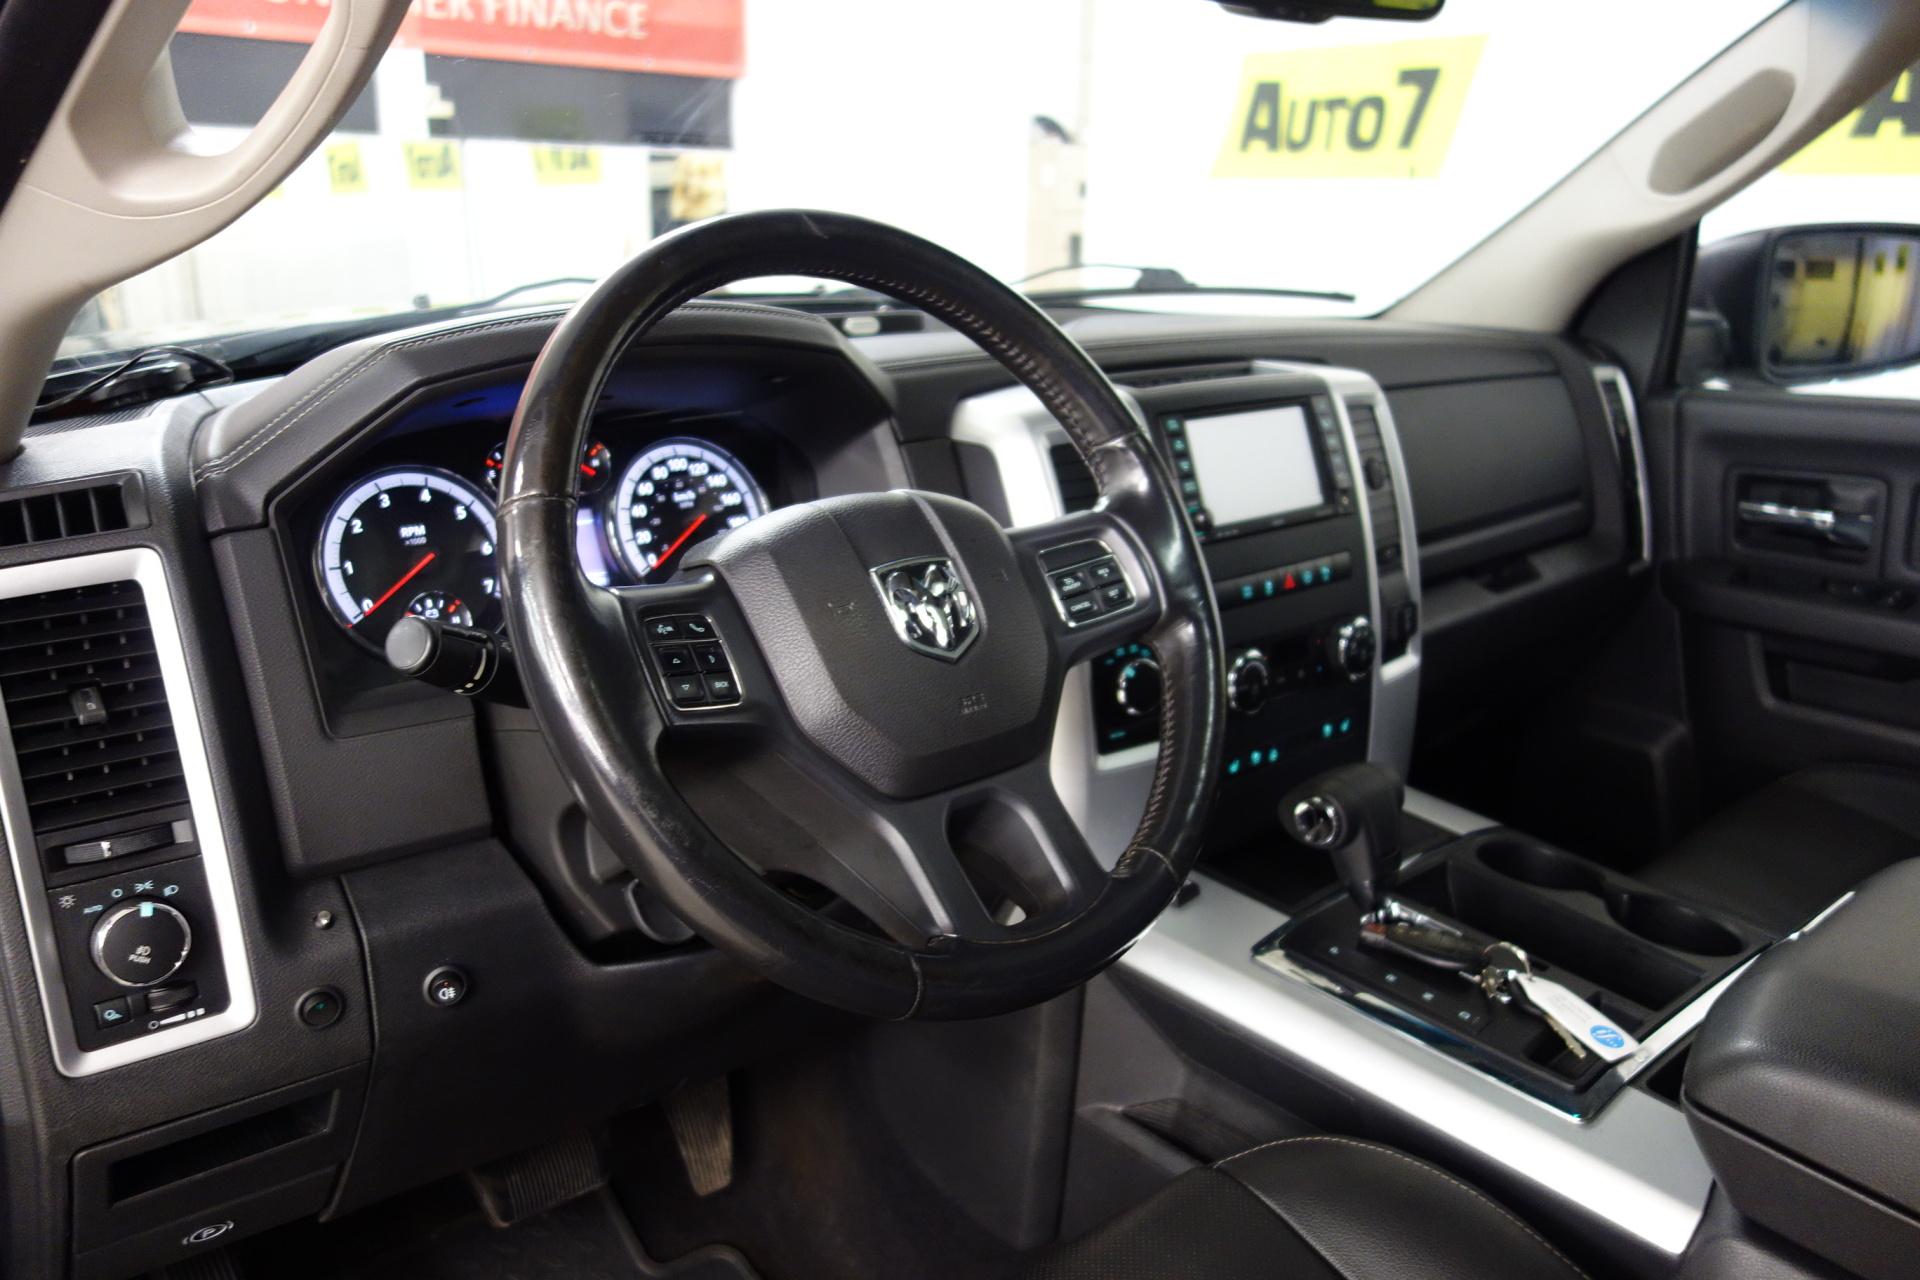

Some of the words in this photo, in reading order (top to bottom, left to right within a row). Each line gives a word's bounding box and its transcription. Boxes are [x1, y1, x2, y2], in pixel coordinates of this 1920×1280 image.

[485, 0, 649, 39] FINANCE
[379, 493, 391, 508] 3
[419, 488, 432, 502] 4
[455, 505, 468, 520] 5
[351, 519, 363, 534] 2
[400, 525, 426, 538] RPM
[480, 541, 493, 555] 6
[344, 560, 354, 576] 1
[482, 578, 494, 593] 7
